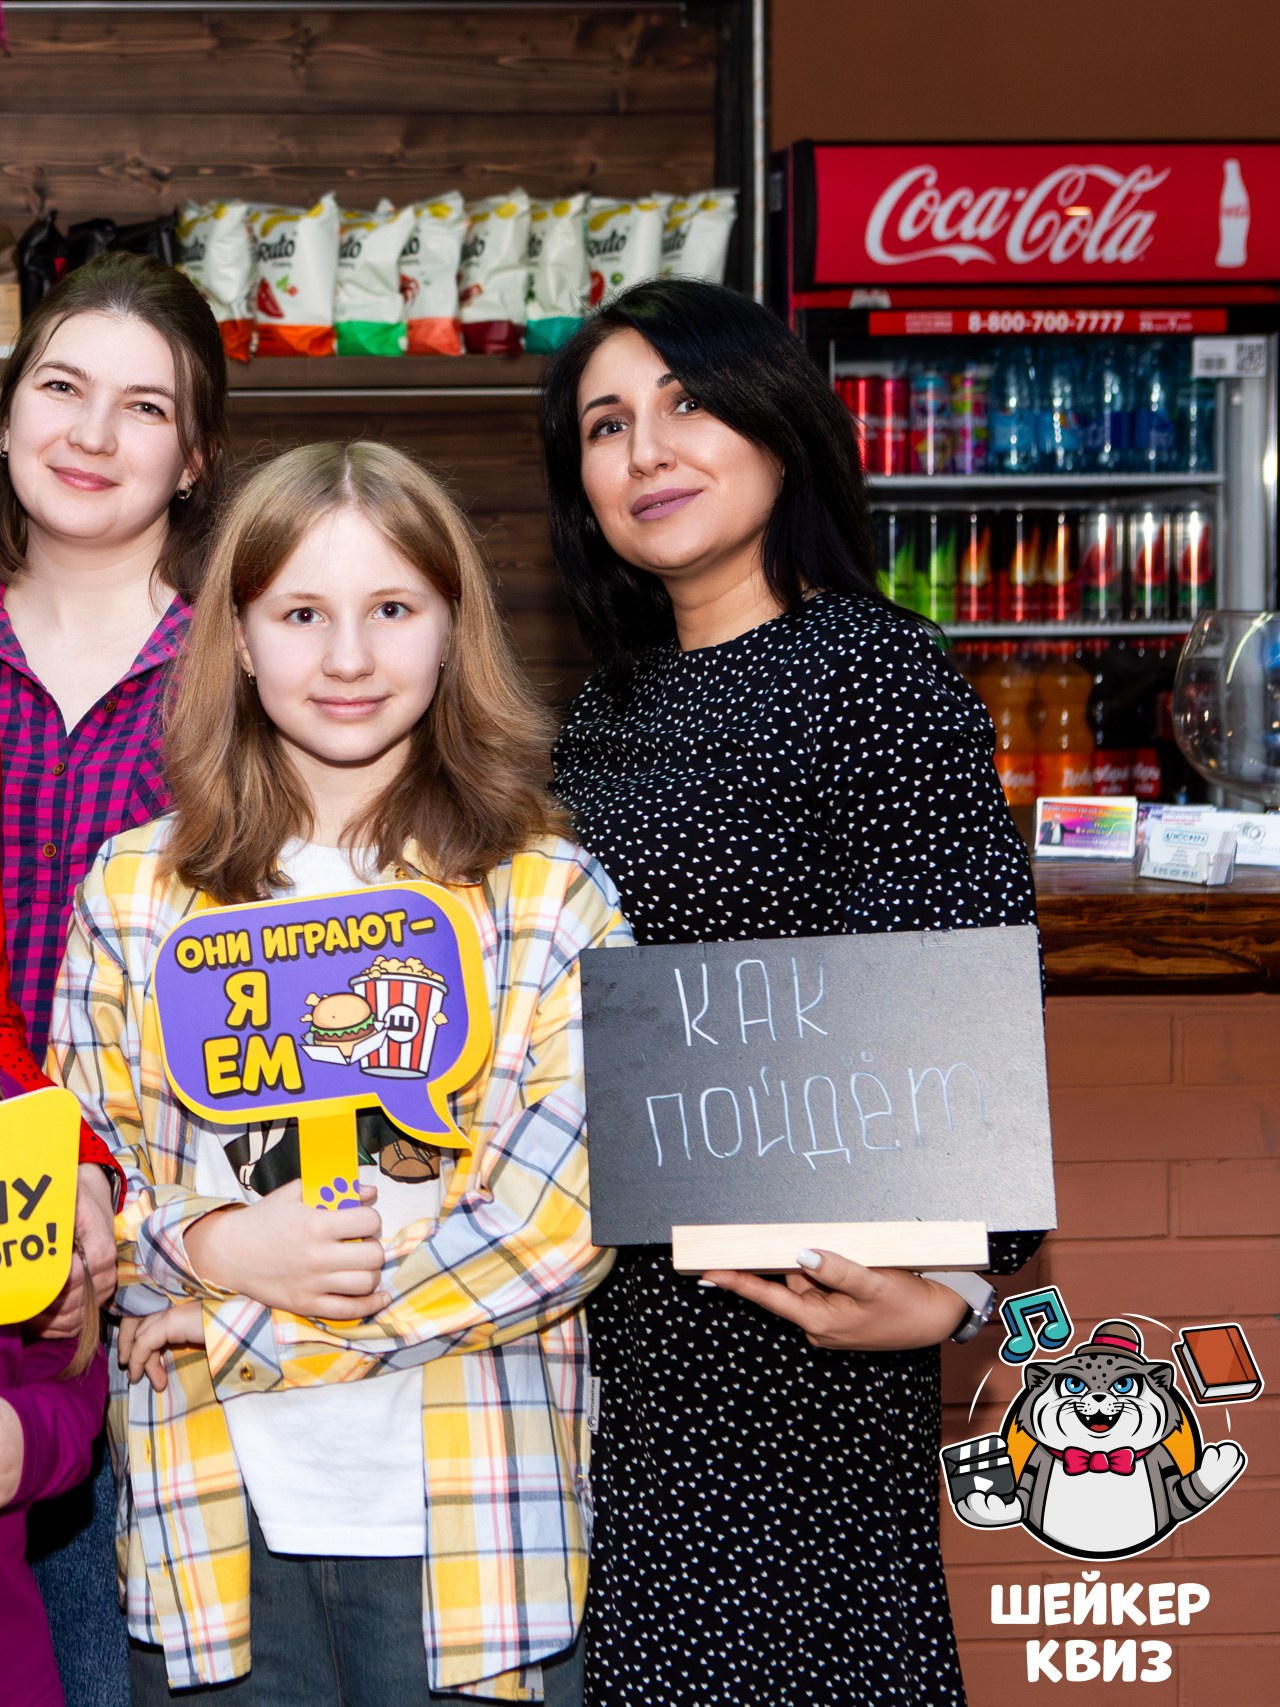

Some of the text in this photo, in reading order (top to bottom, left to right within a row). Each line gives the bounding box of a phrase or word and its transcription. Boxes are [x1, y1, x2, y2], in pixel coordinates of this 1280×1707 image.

[968, 311, 1124, 332] 8-800-700-7777
[175, 932, 252, 972] ОНИ
[224, 969, 270, 1029] Я
[674, 957, 829, 1047] КАК
[203, 1033, 304, 1099] ЕМ
